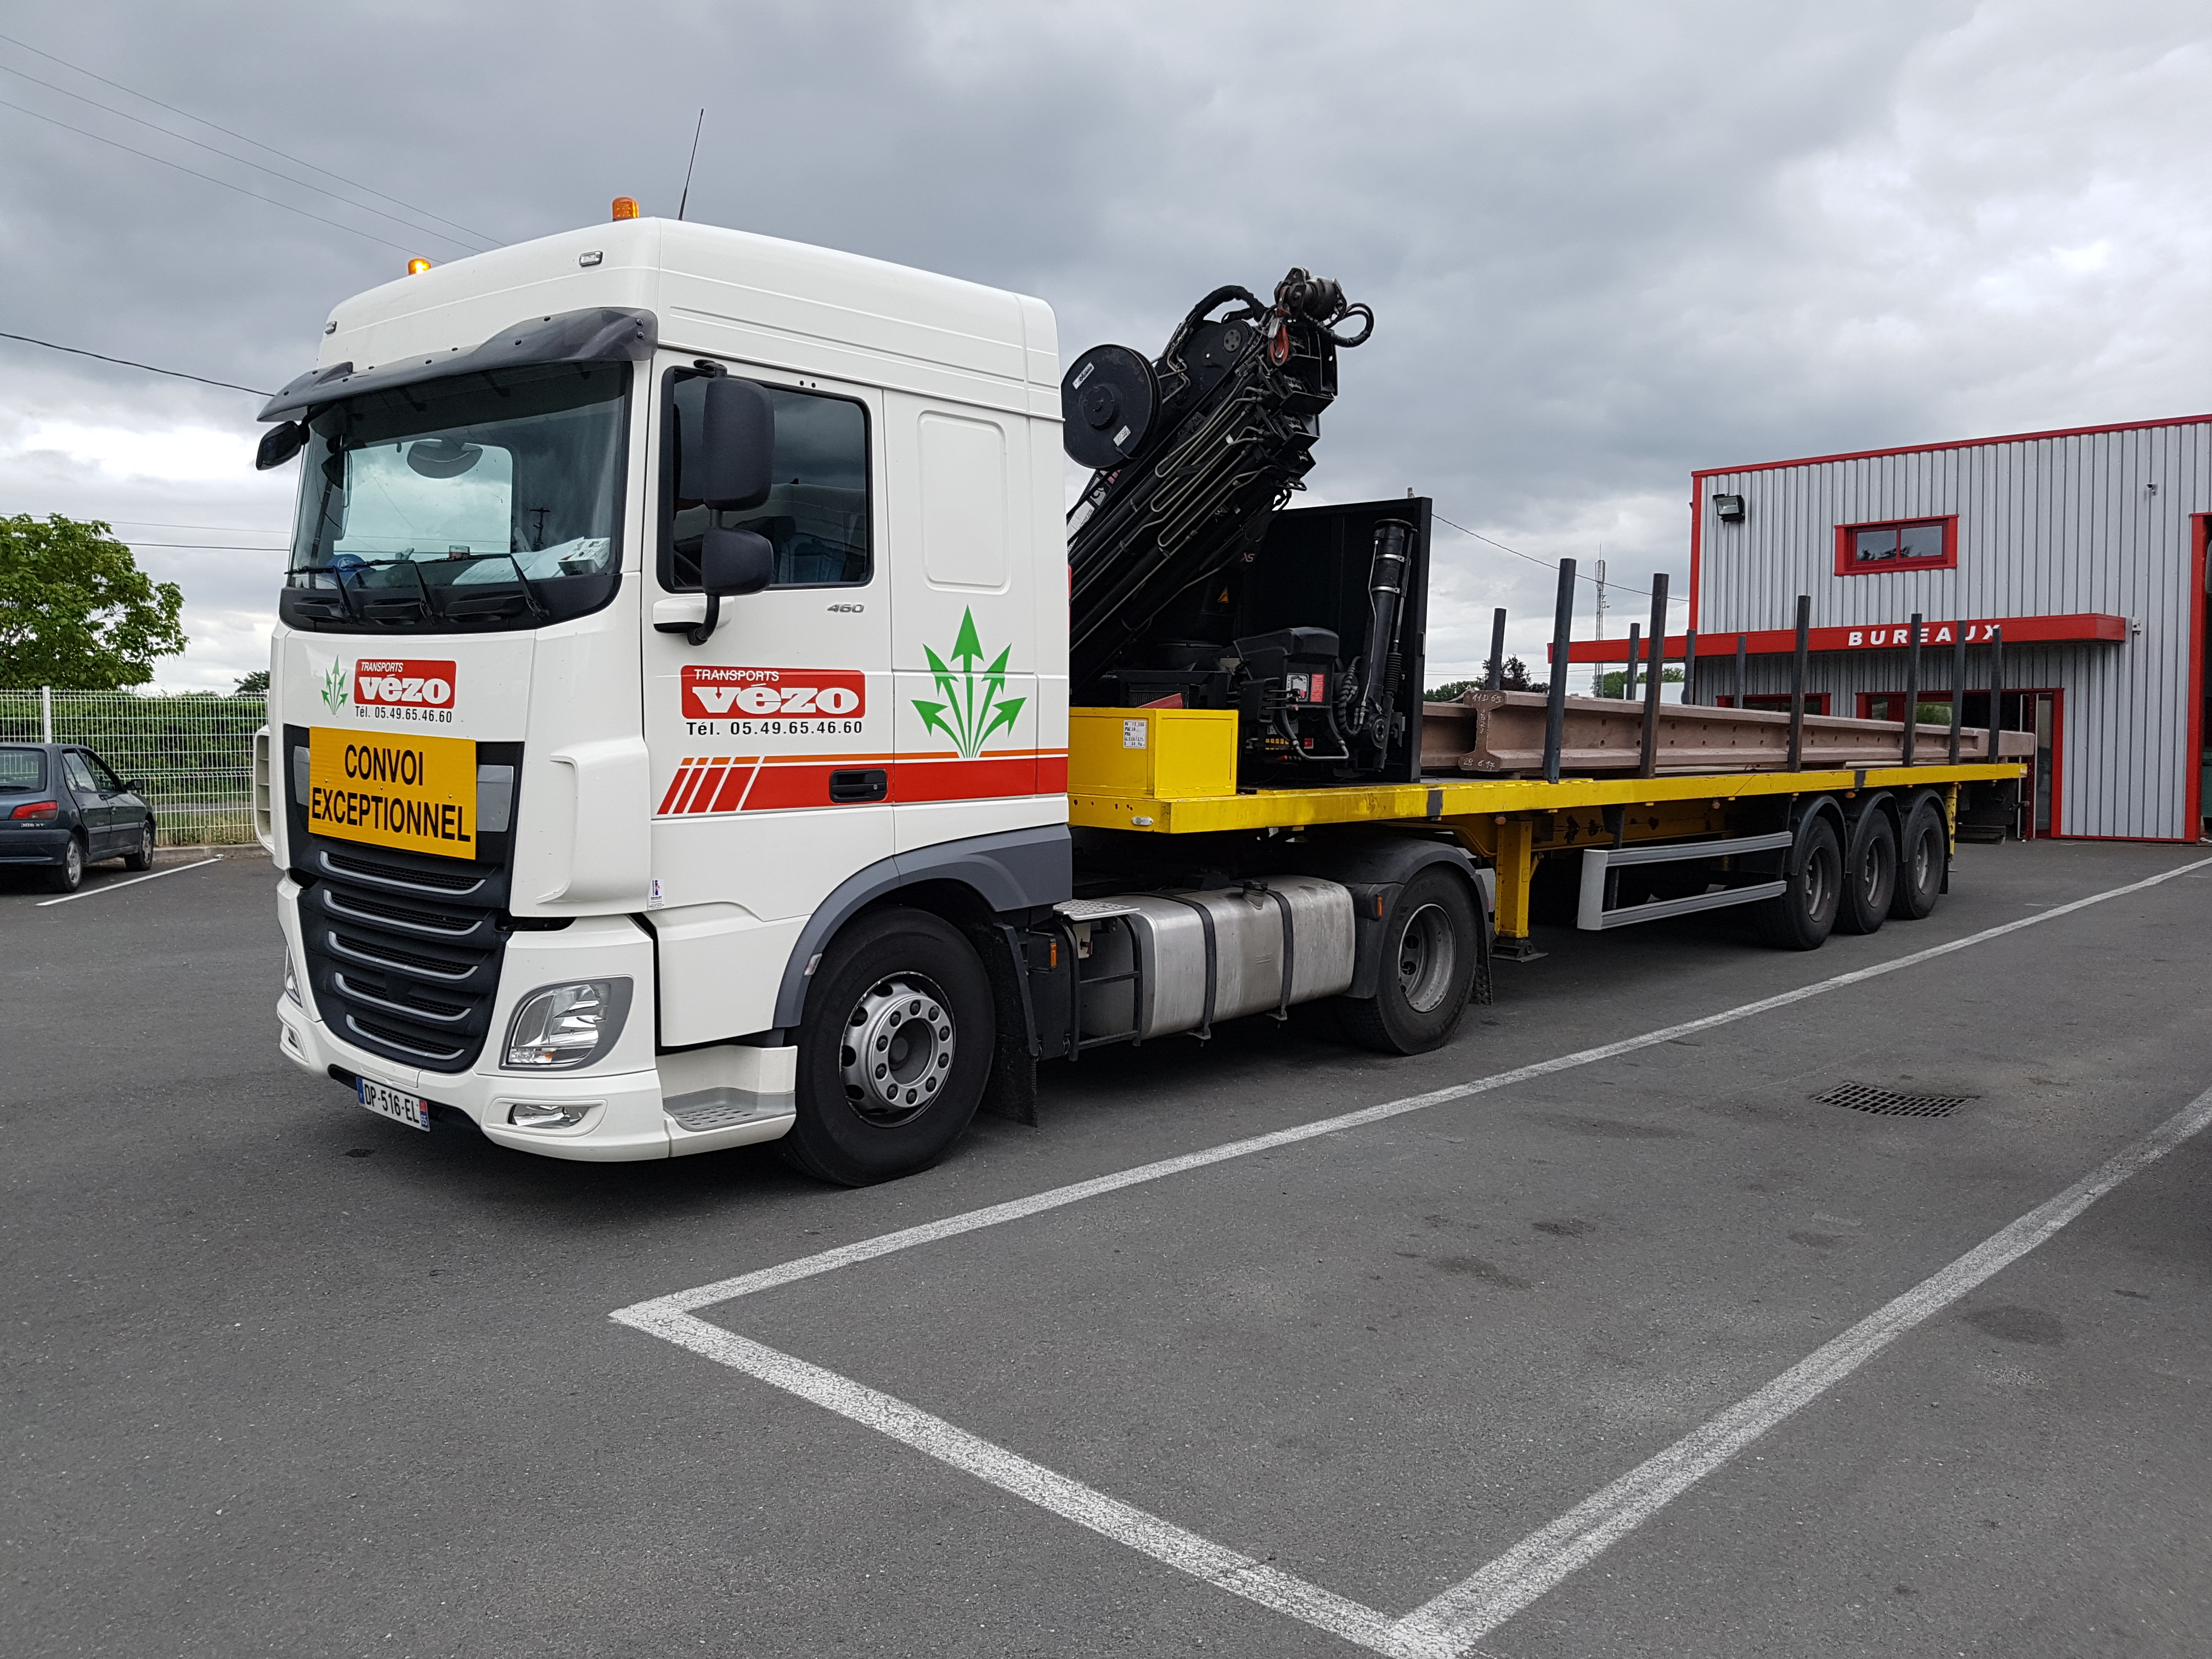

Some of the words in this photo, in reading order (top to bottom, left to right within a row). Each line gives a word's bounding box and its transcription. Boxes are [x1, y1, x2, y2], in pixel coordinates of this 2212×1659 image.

[827, 604, 865, 613] 460
[361, 662, 403, 672] TRANSPORTS
[694, 669, 779, 681] TRANSPORTS
[359, 674, 451, 704] vézo
[692, 683, 859, 714] vézo
[355, 706, 370, 718] Tél.
[375, 707, 452, 723] 05.49.65.46.60
[686, 721, 720, 736] Tél.
[730, 721, 862, 735] 05.49.65.46.60
[345, 744, 423, 786] CONVOI
[312, 787, 471, 842] EXCEPTIONNEL
[364, 1084, 419, 1124] DP-516-EL
